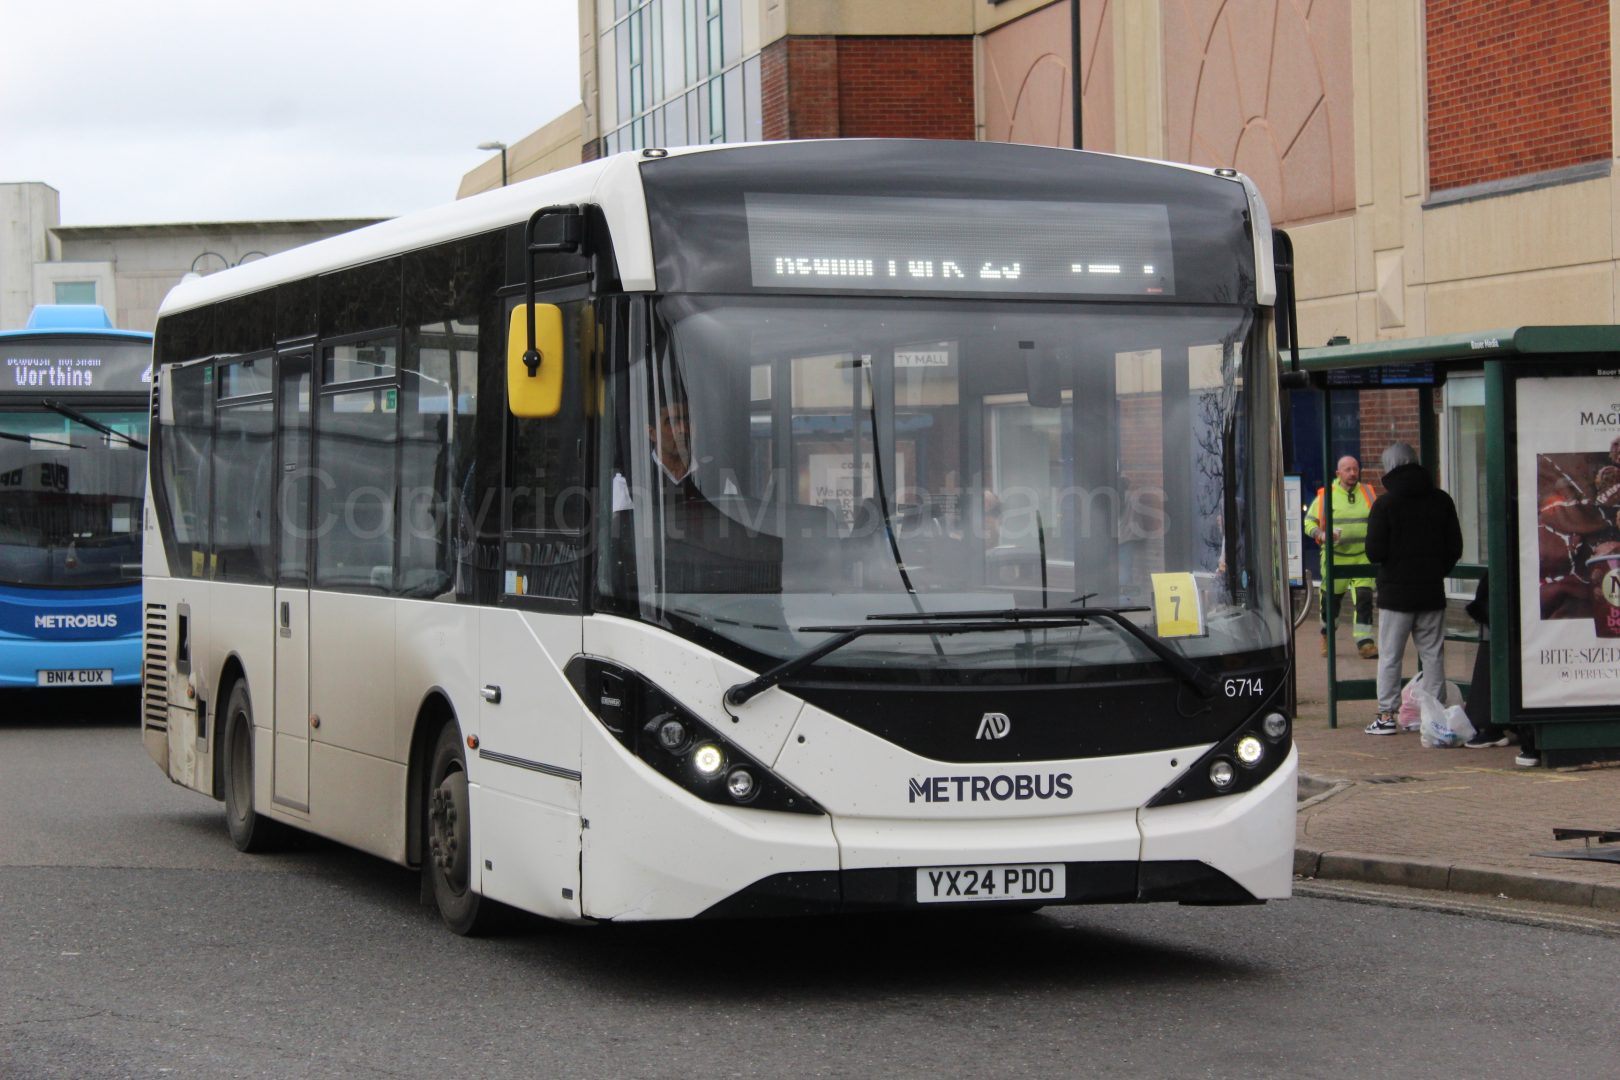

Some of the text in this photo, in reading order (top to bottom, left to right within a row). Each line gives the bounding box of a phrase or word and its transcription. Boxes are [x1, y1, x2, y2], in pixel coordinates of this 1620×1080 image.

[915, 354, 946, 365] MALL
[16, 366, 93, 386] Worthing
[1170, 595, 1181, 622] 7
[34, 614, 118, 629] METROBUS
[46, 671, 104, 683] BN14 CUX
[1224, 677, 1263, 697] 6714
[908, 772, 1073, 804] METROBUS
[928, 867, 1054, 897] YX24 PDO
